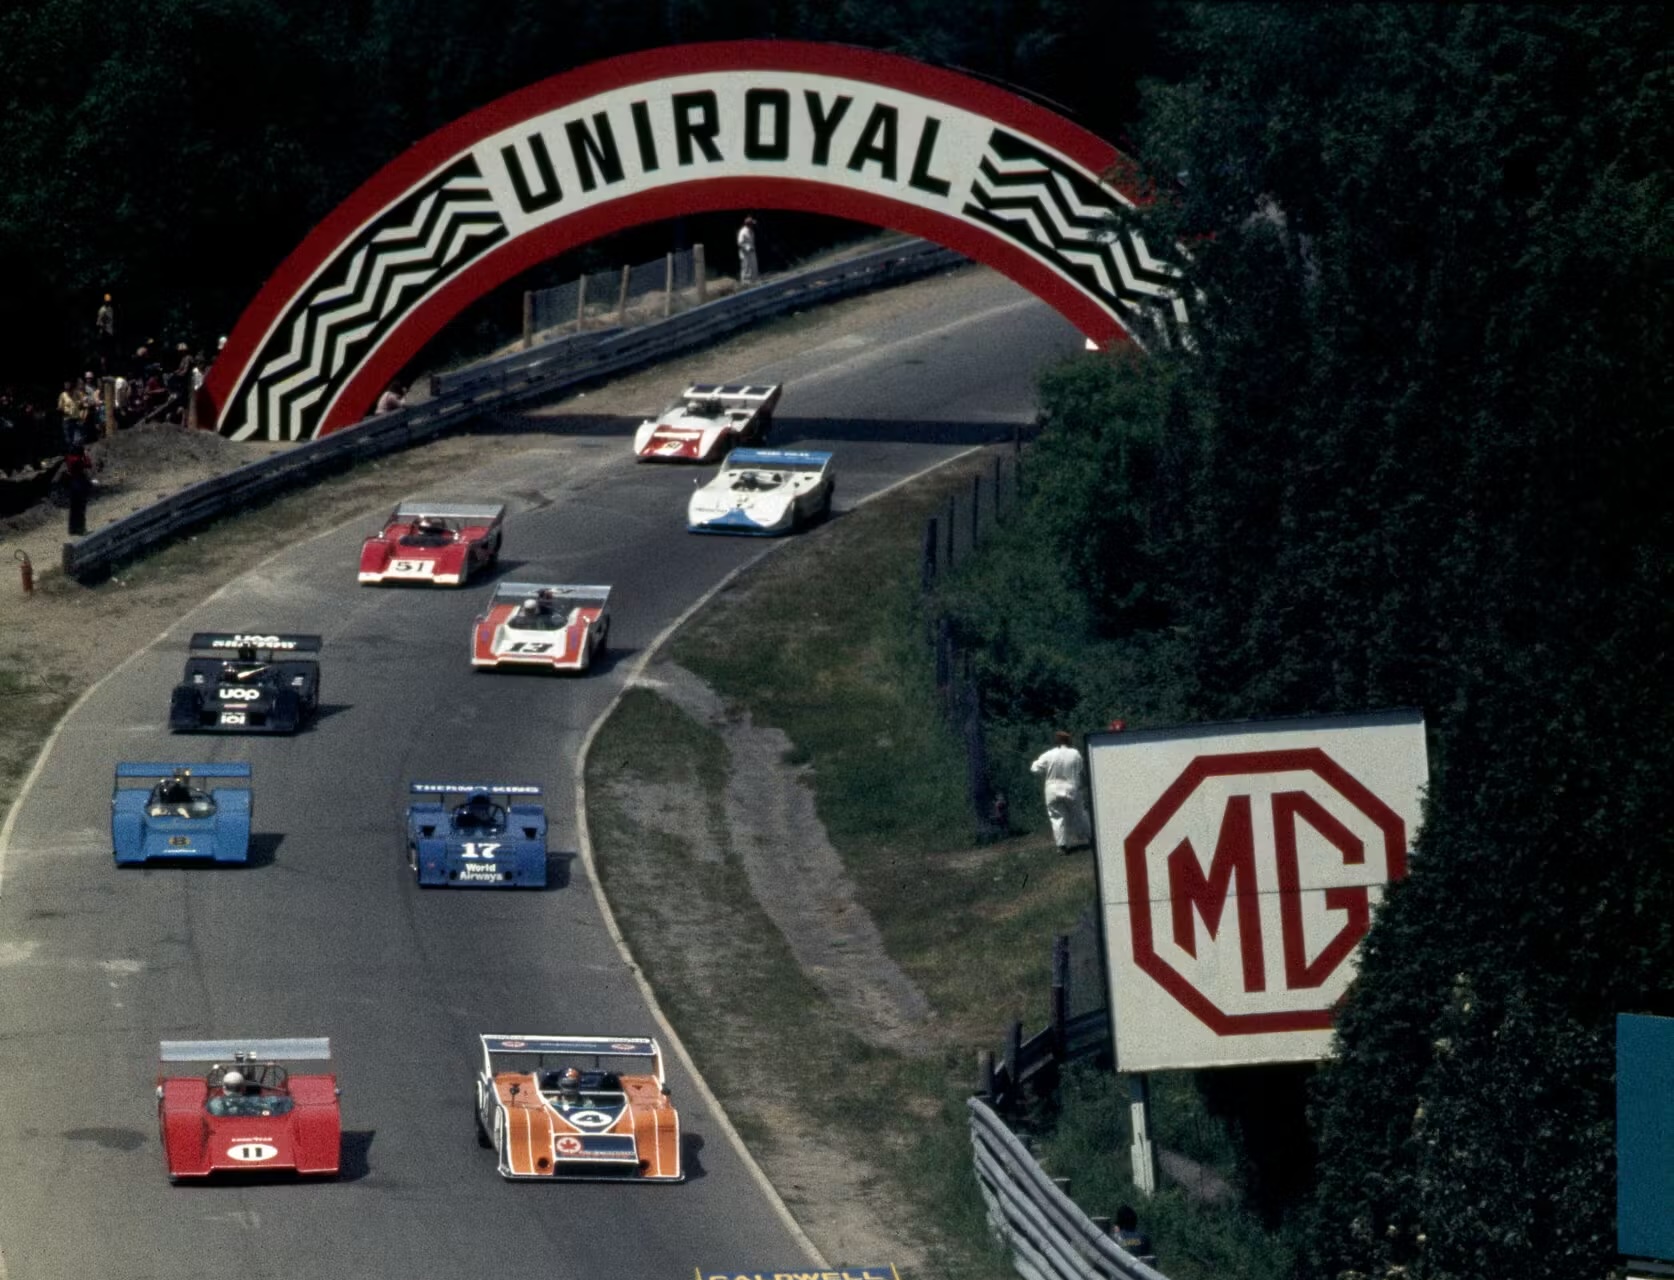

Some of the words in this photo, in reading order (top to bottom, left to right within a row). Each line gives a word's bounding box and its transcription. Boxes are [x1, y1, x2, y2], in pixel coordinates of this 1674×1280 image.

[501, 88, 951, 214] UNIROYAL
[395, 561, 424, 572] 51
[508, 642, 553, 653] 13
[461, 842, 502, 858] 17
[465, 863, 496, 872] World
[1167, 789, 1370, 993] MG
[243, 1147, 262, 1158] 11
